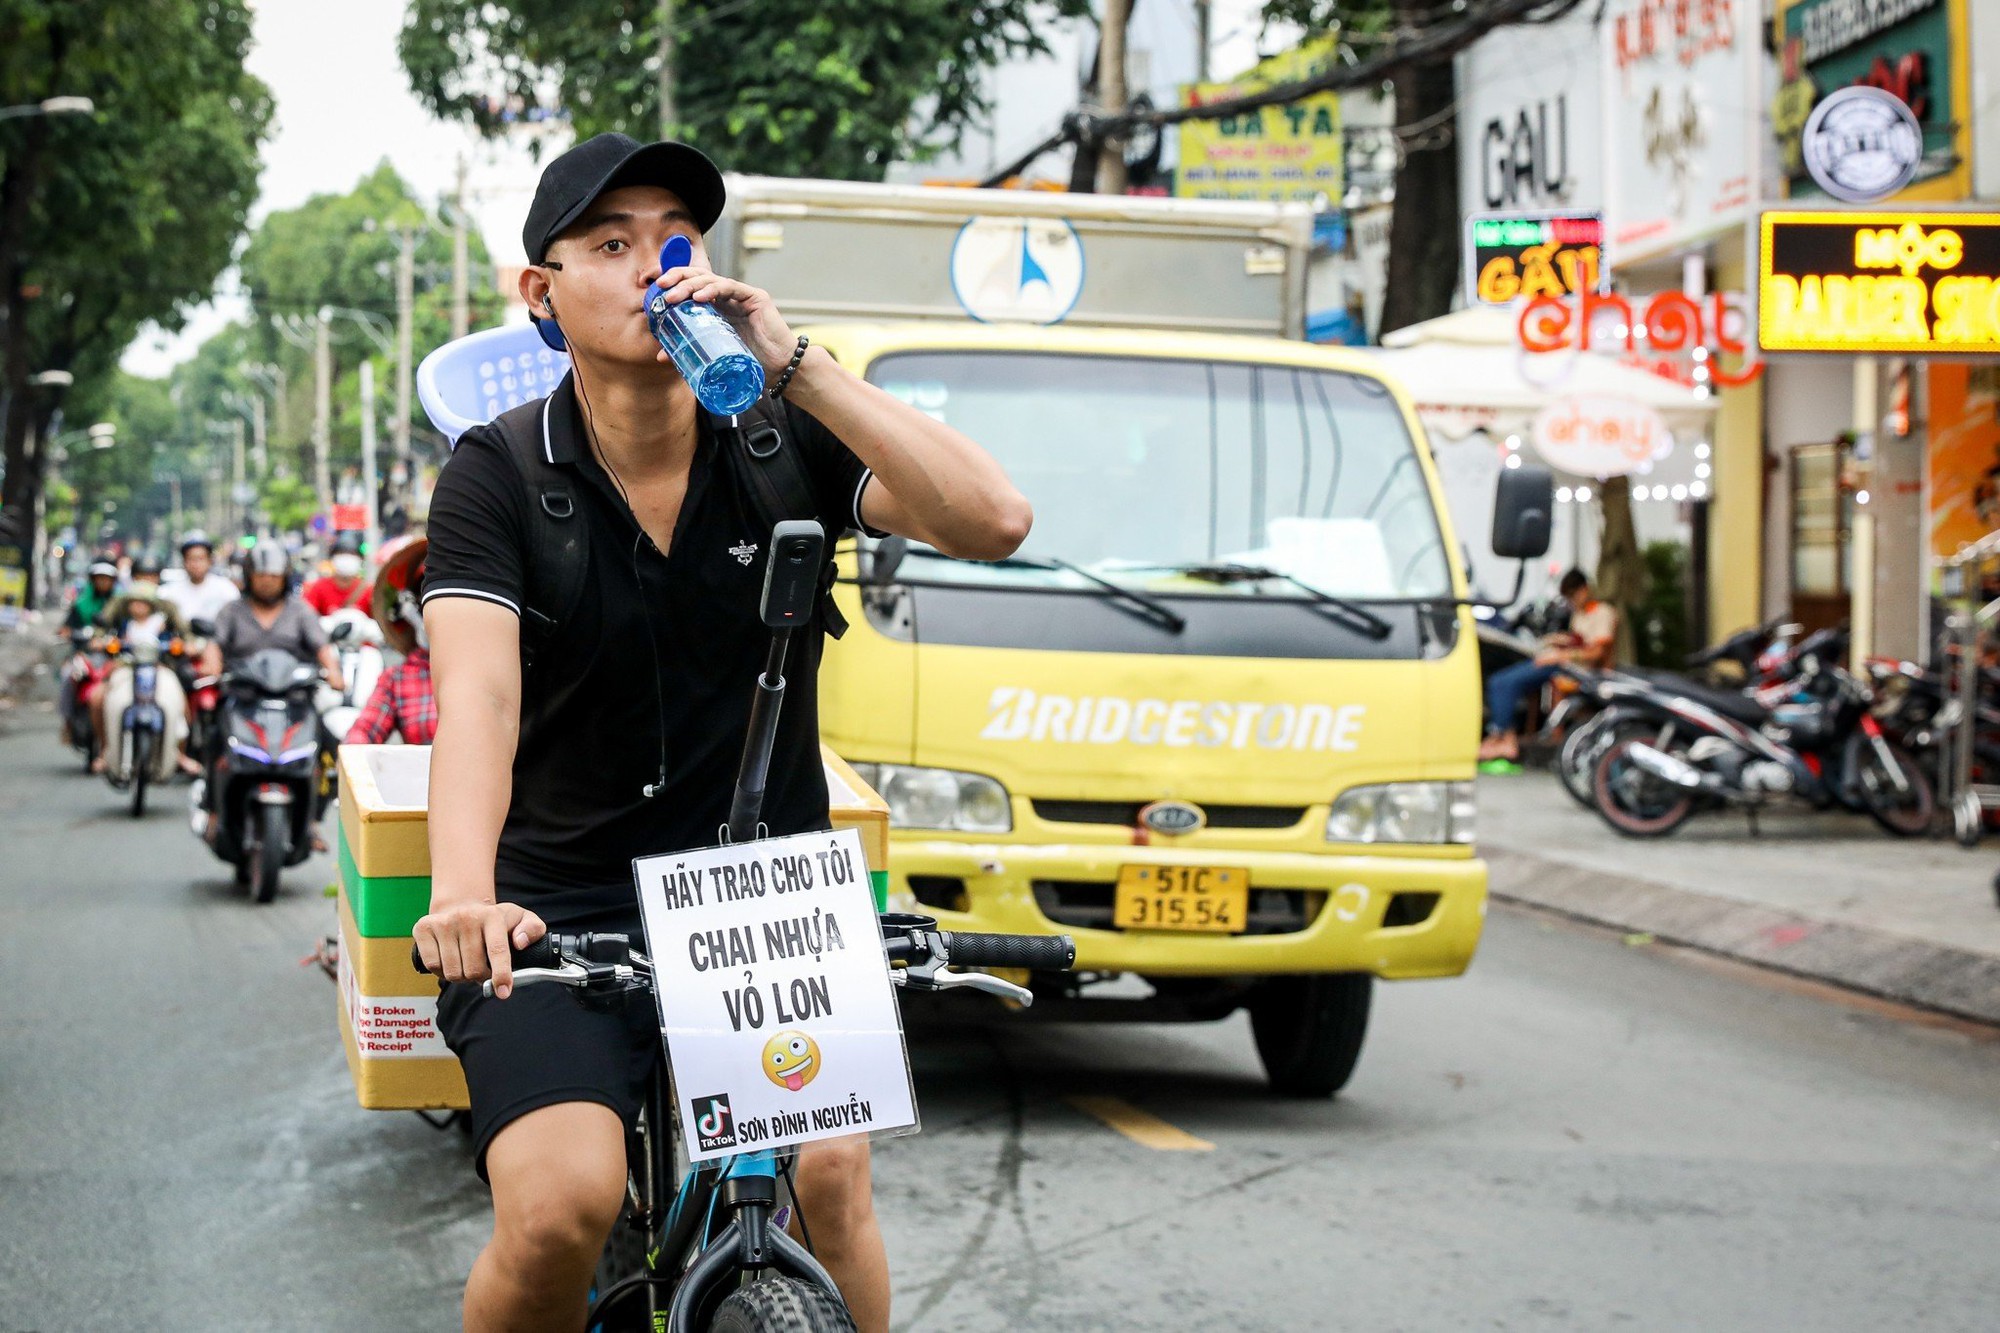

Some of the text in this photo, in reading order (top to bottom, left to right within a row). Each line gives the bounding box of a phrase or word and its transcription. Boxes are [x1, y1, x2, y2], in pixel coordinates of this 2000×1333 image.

[980, 686, 1367, 752] BRIDGESTONE
[662, 840, 855, 910] HÃY TRAO CHO TÔI
[1158, 865, 1210, 895] 51C
[688, 907, 846, 972] CHAI NHỰA
[373, 1006, 415, 1015] Broken
[722, 970, 832, 1032] VỎ LON
[374, 1017, 431, 1028] Damaged
[395, 1029, 435, 1039] Before
[367, 1041, 412, 1052] Receipt
[737, 1092, 873, 1144] SƠN ĐÌNH NGUYỄN
[700, 1134, 735, 1148] TikTok
